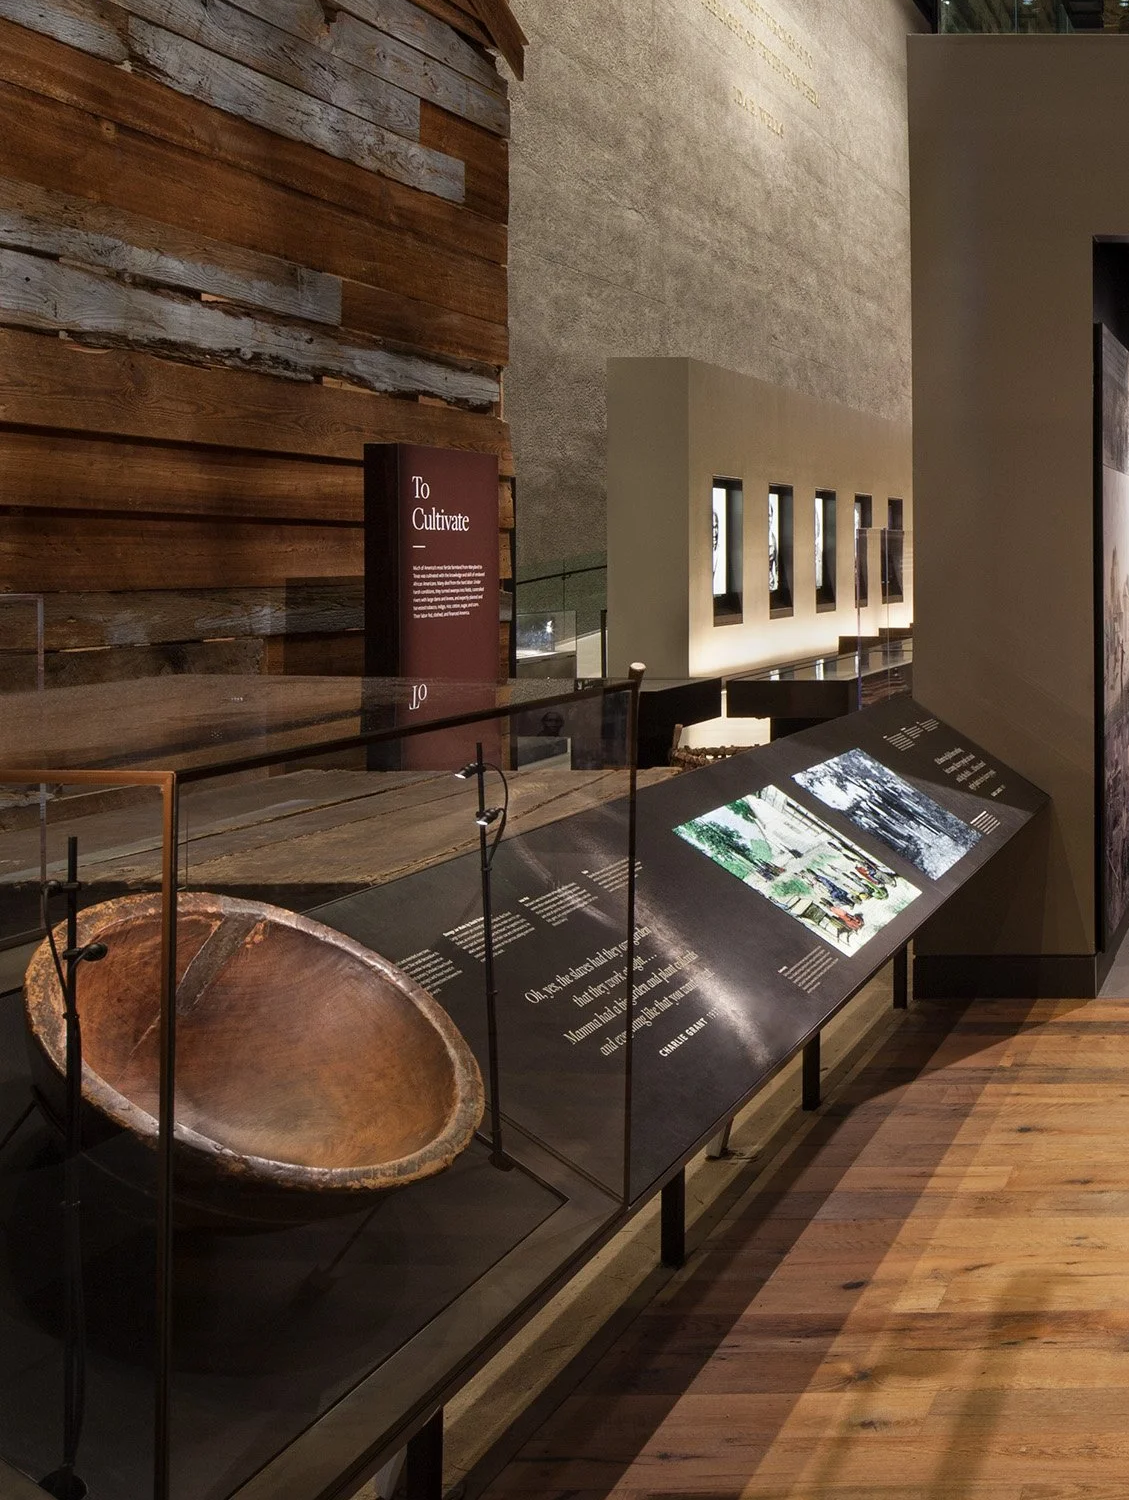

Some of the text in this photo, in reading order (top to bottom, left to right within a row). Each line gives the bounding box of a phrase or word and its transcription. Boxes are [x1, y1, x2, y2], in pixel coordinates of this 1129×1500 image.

[412, 475, 430, 499] To
[412, 506, 470, 531] Cultivate
[525, 989, 549, 1003] Oh,
[542, 983, 563, 999] yes,
[556, 974, 574, 987] the
[569, 967, 595, 980] slaves
[586, 951, 608, 968] had
[602, 948, 623, 960] they
[572, 995, 594, 1008] that
[588, 985, 611, 998] they
[605, 970, 627, 988] work
[563, 1019, 603, 1046] Mamma
[594, 1006, 617, 1024] had
[613, 1006, 623, 1015] a
[646, 972, 663, 988] and
[657, 964, 678, 983] plant
[600, 1037, 619, 1056] and
[641, 1007, 660, 1021] like
[654, 996, 673, 1012] that
[668, 990, 685, 1005] you
[659, 1033, 688, 1057] CHARLIE
[685, 1017, 708, 1036] GRANT
